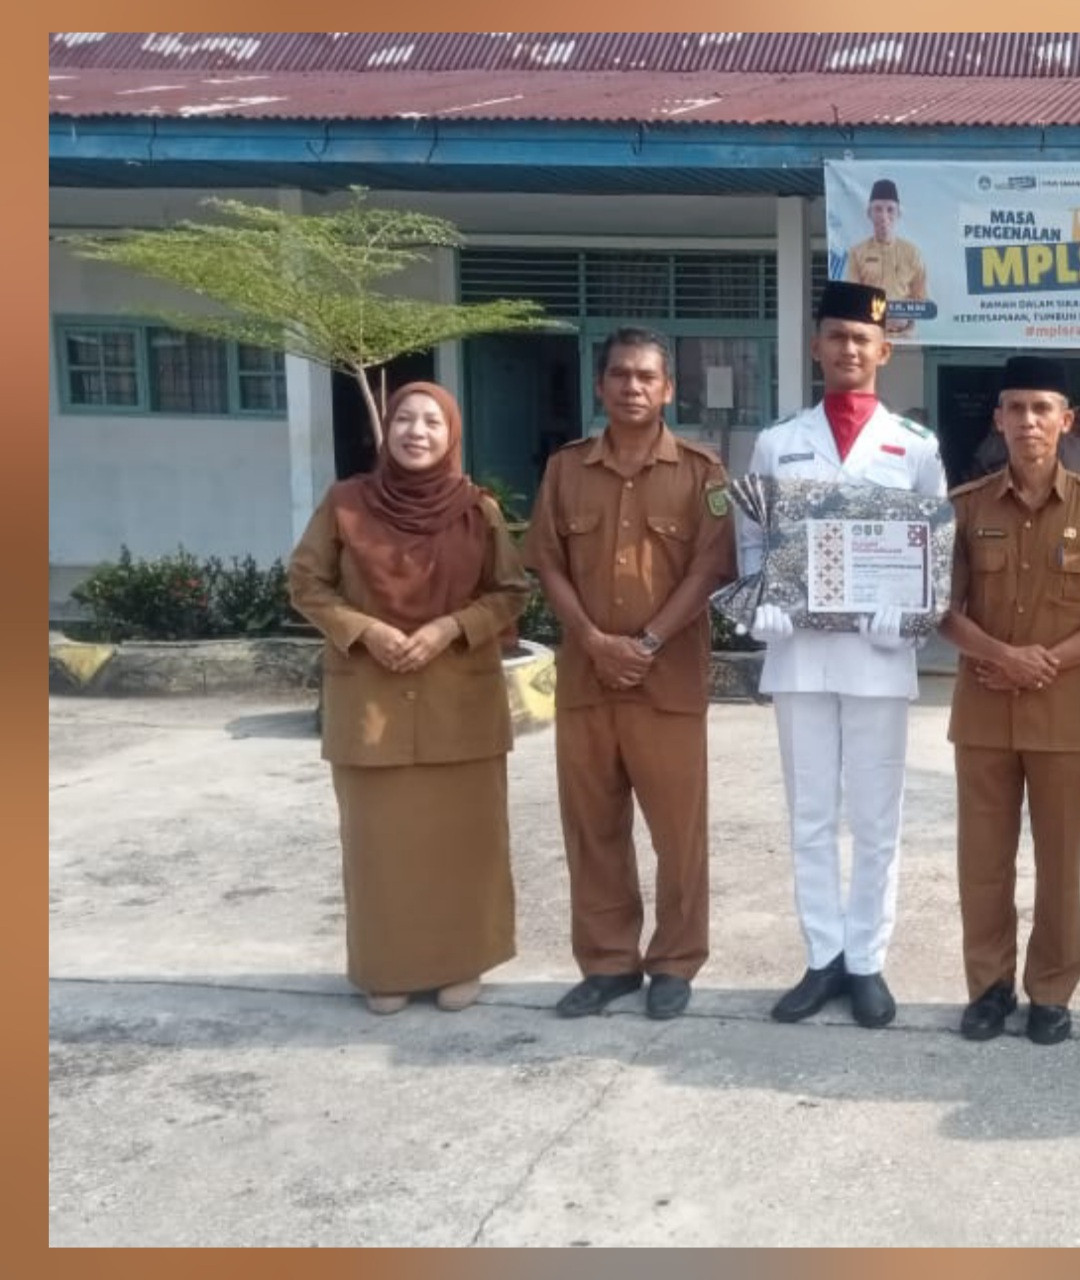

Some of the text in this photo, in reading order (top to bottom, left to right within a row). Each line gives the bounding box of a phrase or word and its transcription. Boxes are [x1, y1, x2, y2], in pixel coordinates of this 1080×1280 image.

[990, 210, 1035, 225] MASA
[964, 225, 1061, 241] PENGENALAN
[1019, 299, 1054, 309] DALAM
